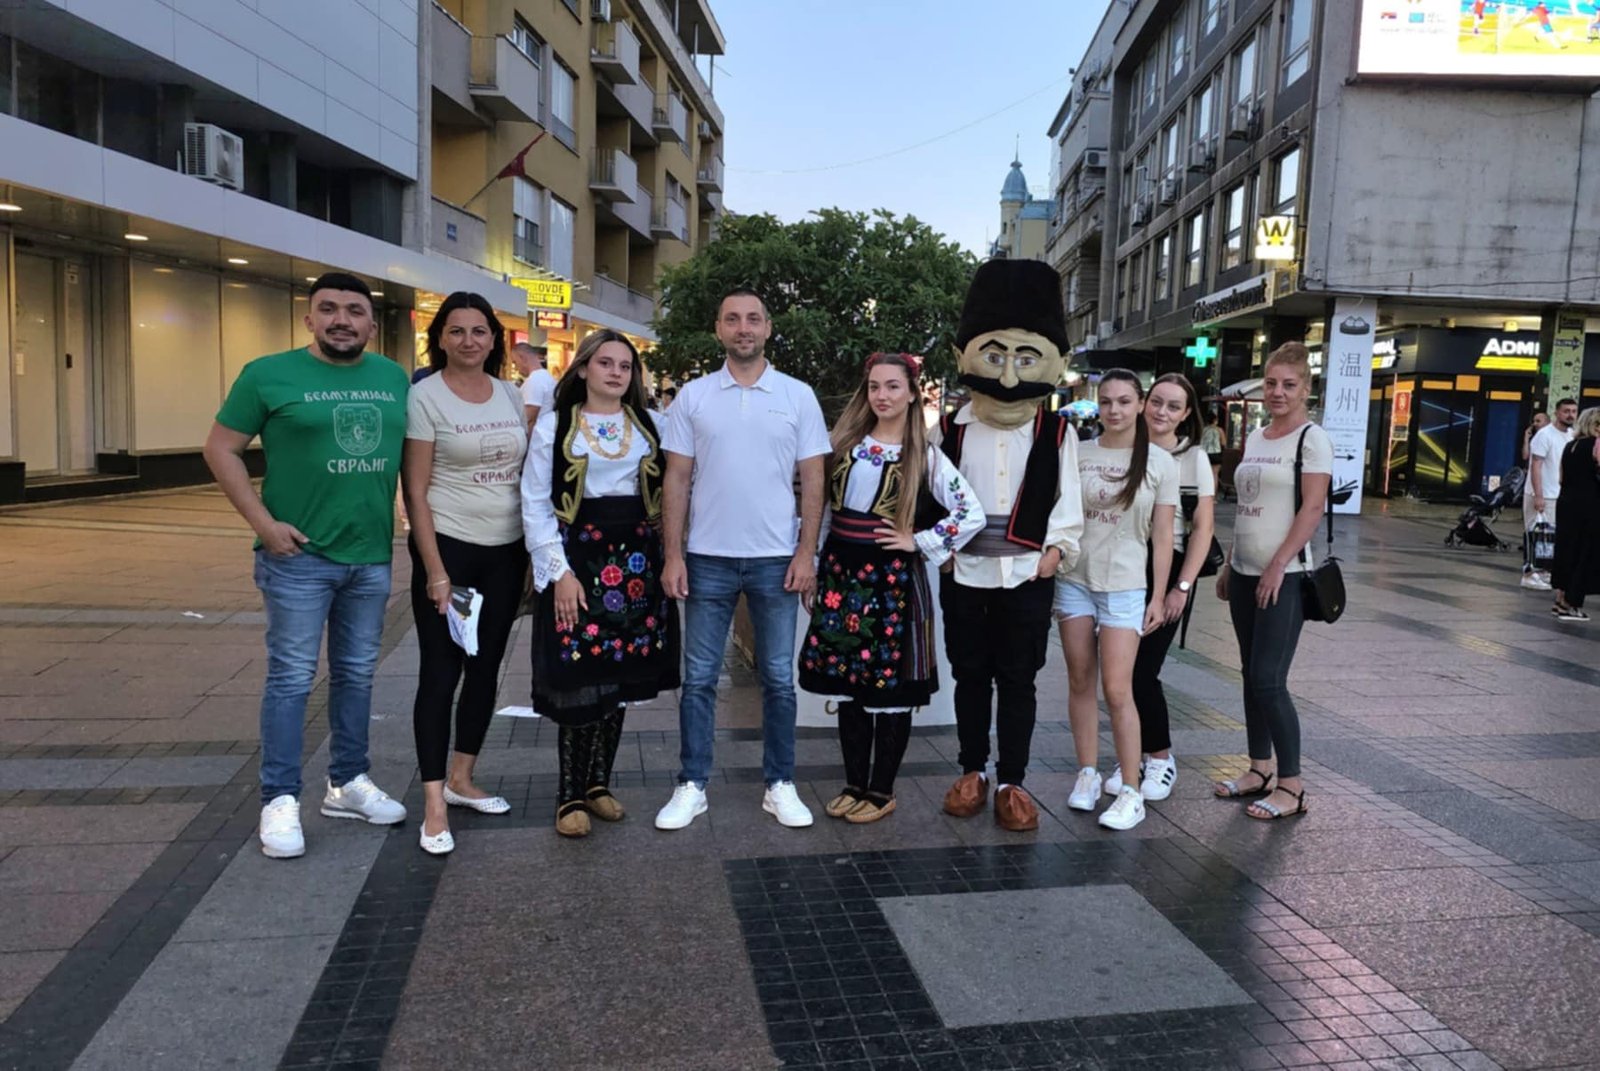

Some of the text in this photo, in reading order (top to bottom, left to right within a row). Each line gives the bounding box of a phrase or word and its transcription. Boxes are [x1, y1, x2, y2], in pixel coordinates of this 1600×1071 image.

[538, 283, 565, 294] OVDE
[1336, 352, 1362, 413] 温州
[327, 458, 389, 474] СВРЉИГ
